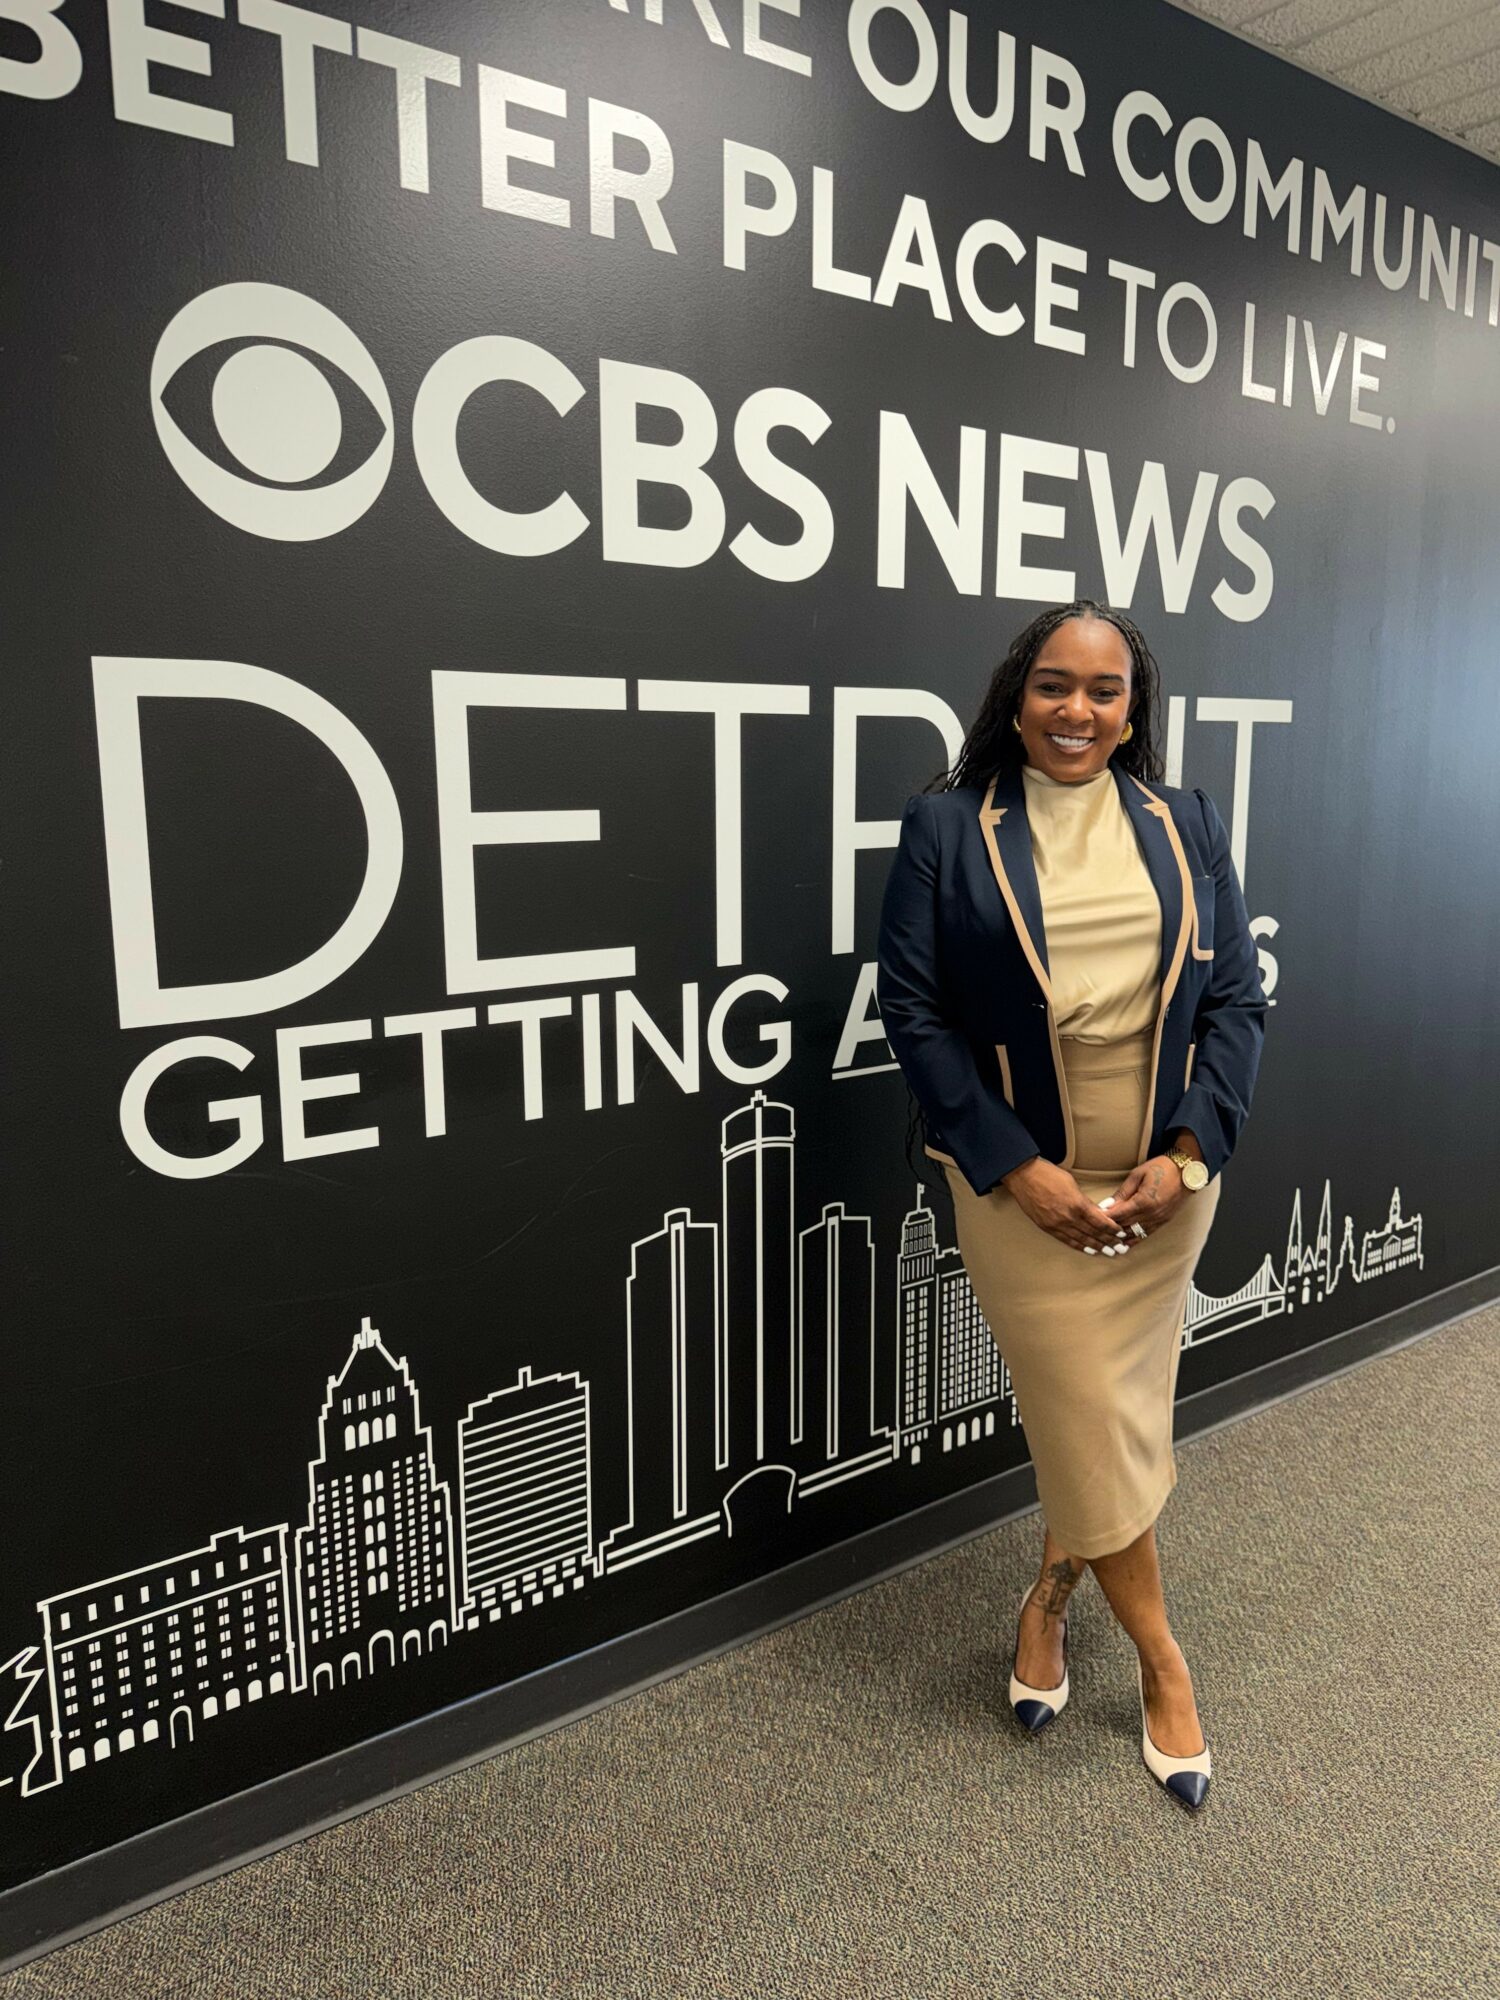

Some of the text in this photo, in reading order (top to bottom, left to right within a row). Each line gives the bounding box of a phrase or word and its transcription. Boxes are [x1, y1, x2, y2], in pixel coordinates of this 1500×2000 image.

[848, 0, 1086, 177] OUR
[723, 138, 1088, 357] PLACE
[1108, 258, 1218, 384] TO
[1241, 301, 1396, 434] LIVE.
[412, 335, 1277, 623] CBS NEWS
[91, 656, 1294, 1030] DETRT
[119, 973, 793, 1180] GETTING
